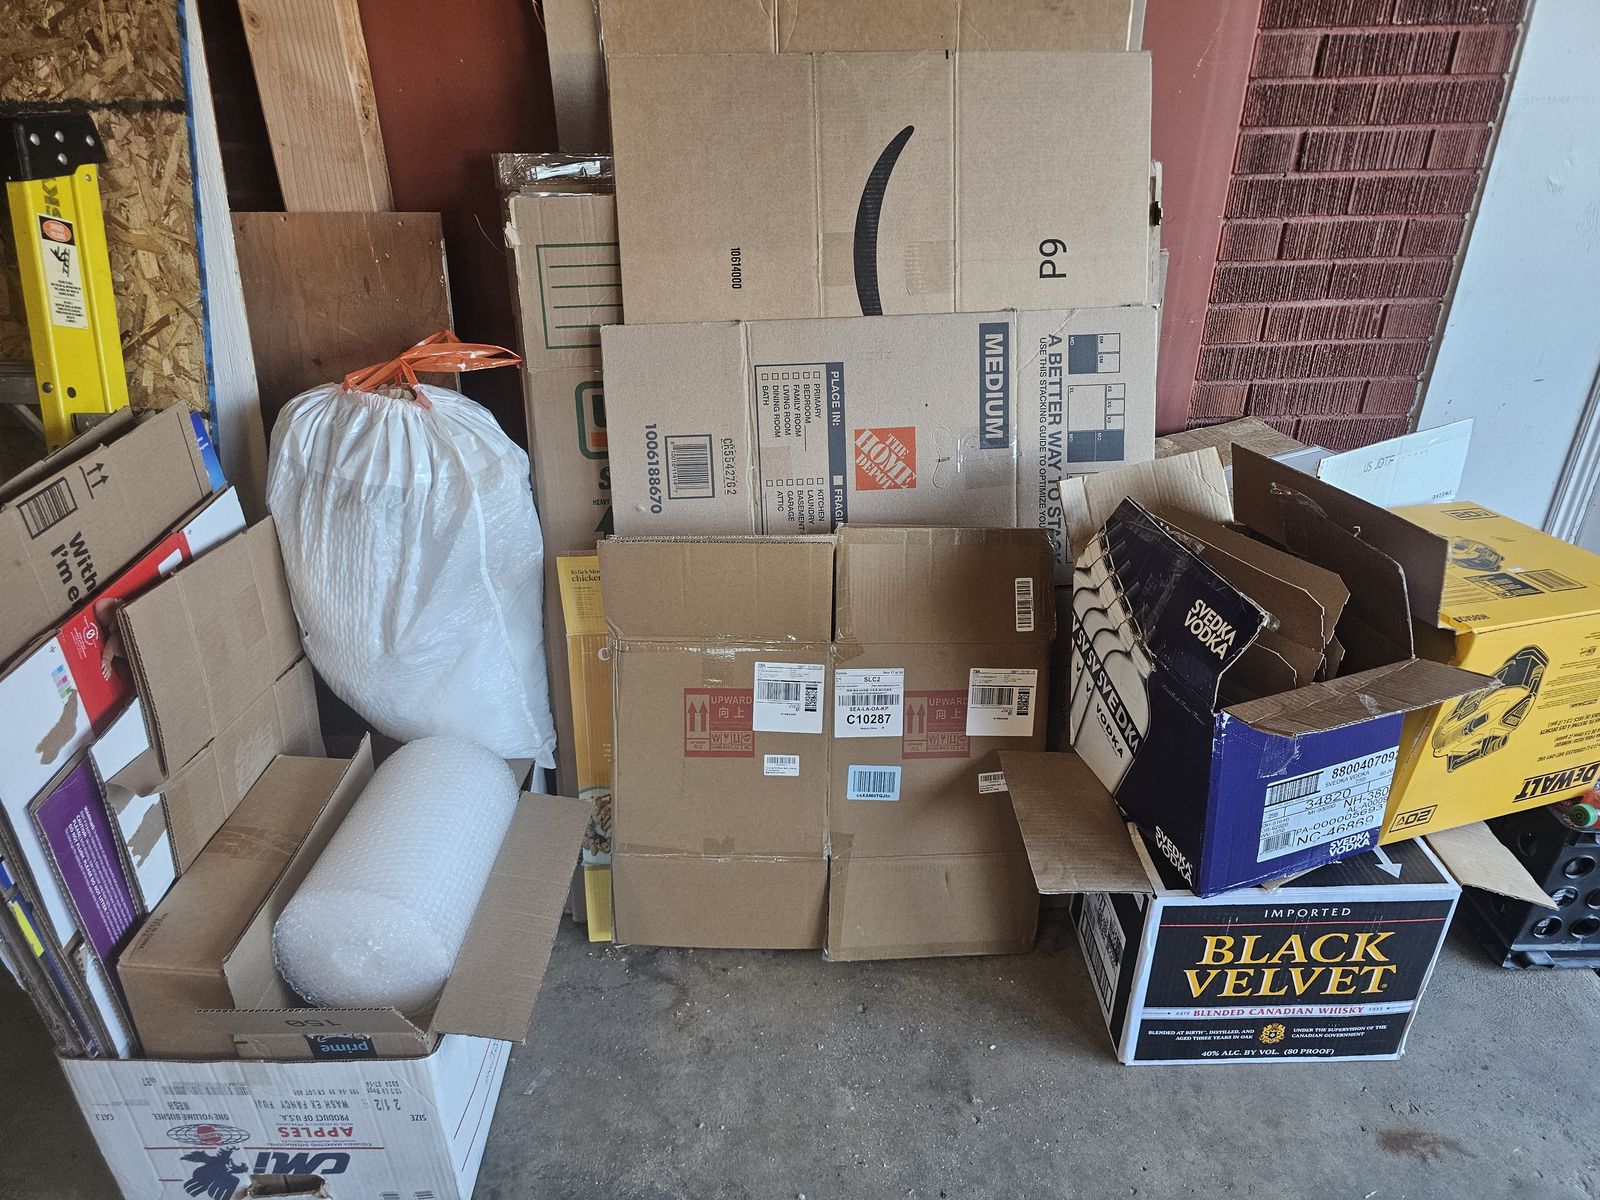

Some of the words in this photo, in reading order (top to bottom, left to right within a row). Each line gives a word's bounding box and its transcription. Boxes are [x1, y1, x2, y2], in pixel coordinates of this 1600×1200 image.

[730, 247, 741, 288] 10614000
[1039, 239, 1066, 278] P9
[1048, 334, 1062, 346] A
[831, 371, 839, 407] PLACE
[984, 334, 1003, 438] MEDIUM
[1048, 353, 1062, 424] BETTER
[832, 411, 840, 425] IN:
[854, 429, 915, 488] HOME
[885, 434, 908, 458] THE
[1047, 431, 1061, 470] WAY
[645, 423, 662, 513] 1006188670
[855, 454, 893, 489] DEPOT
[1039, 454, 1045, 465] TO
[1047, 475, 1060, 500] TO
[1190, 598, 1237, 646] SVEDKA
[1183, 610, 1228, 660] VODKA
[718, 707, 744, 718] 向上
[846, 714, 891, 724] C10287
[935, 709, 961, 719] 向上
[1096, 670, 1142, 753] SVEDKA
[1096, 702, 1123, 758] VODKA
[1325, 776, 1348, 787] SVEDKA
[1349, 770, 1368, 780] VODKA
[1304, 787, 1350, 809] 34820
[1295, 803, 1382, 835] PA-000005693
[1296, 815, 1372, 846] NC-46869
[1155, 824, 1193, 875] SVEDKA
[1328, 838, 1370, 856] VODKA
[1329, 831, 1370, 849] SVEDKA
[68, 823, 73, 832] DO
[82, 859, 92, 878] PLEASE
[90, 877, 96, 885] DO
[1156, 835, 1192, 887] VODKA
[1264, 907, 1351, 917] IMPORTED
[1196, 931, 1395, 964] BLACK
[1183, 964, 1396, 998] VELVET
[1249, 1007, 1312, 1015] CANADIAN
[320, 1040, 368, 1052] prime
[152, 1112, 180, 1120] BUSHEL
[279, 1100, 306, 1108] FANCY
[309, 1100, 320, 1108] EX
[324, 1099, 348, 1108] WASH
[393, 1098, 400, 1110] 2
[277, 1126, 352, 1137] APPLES
